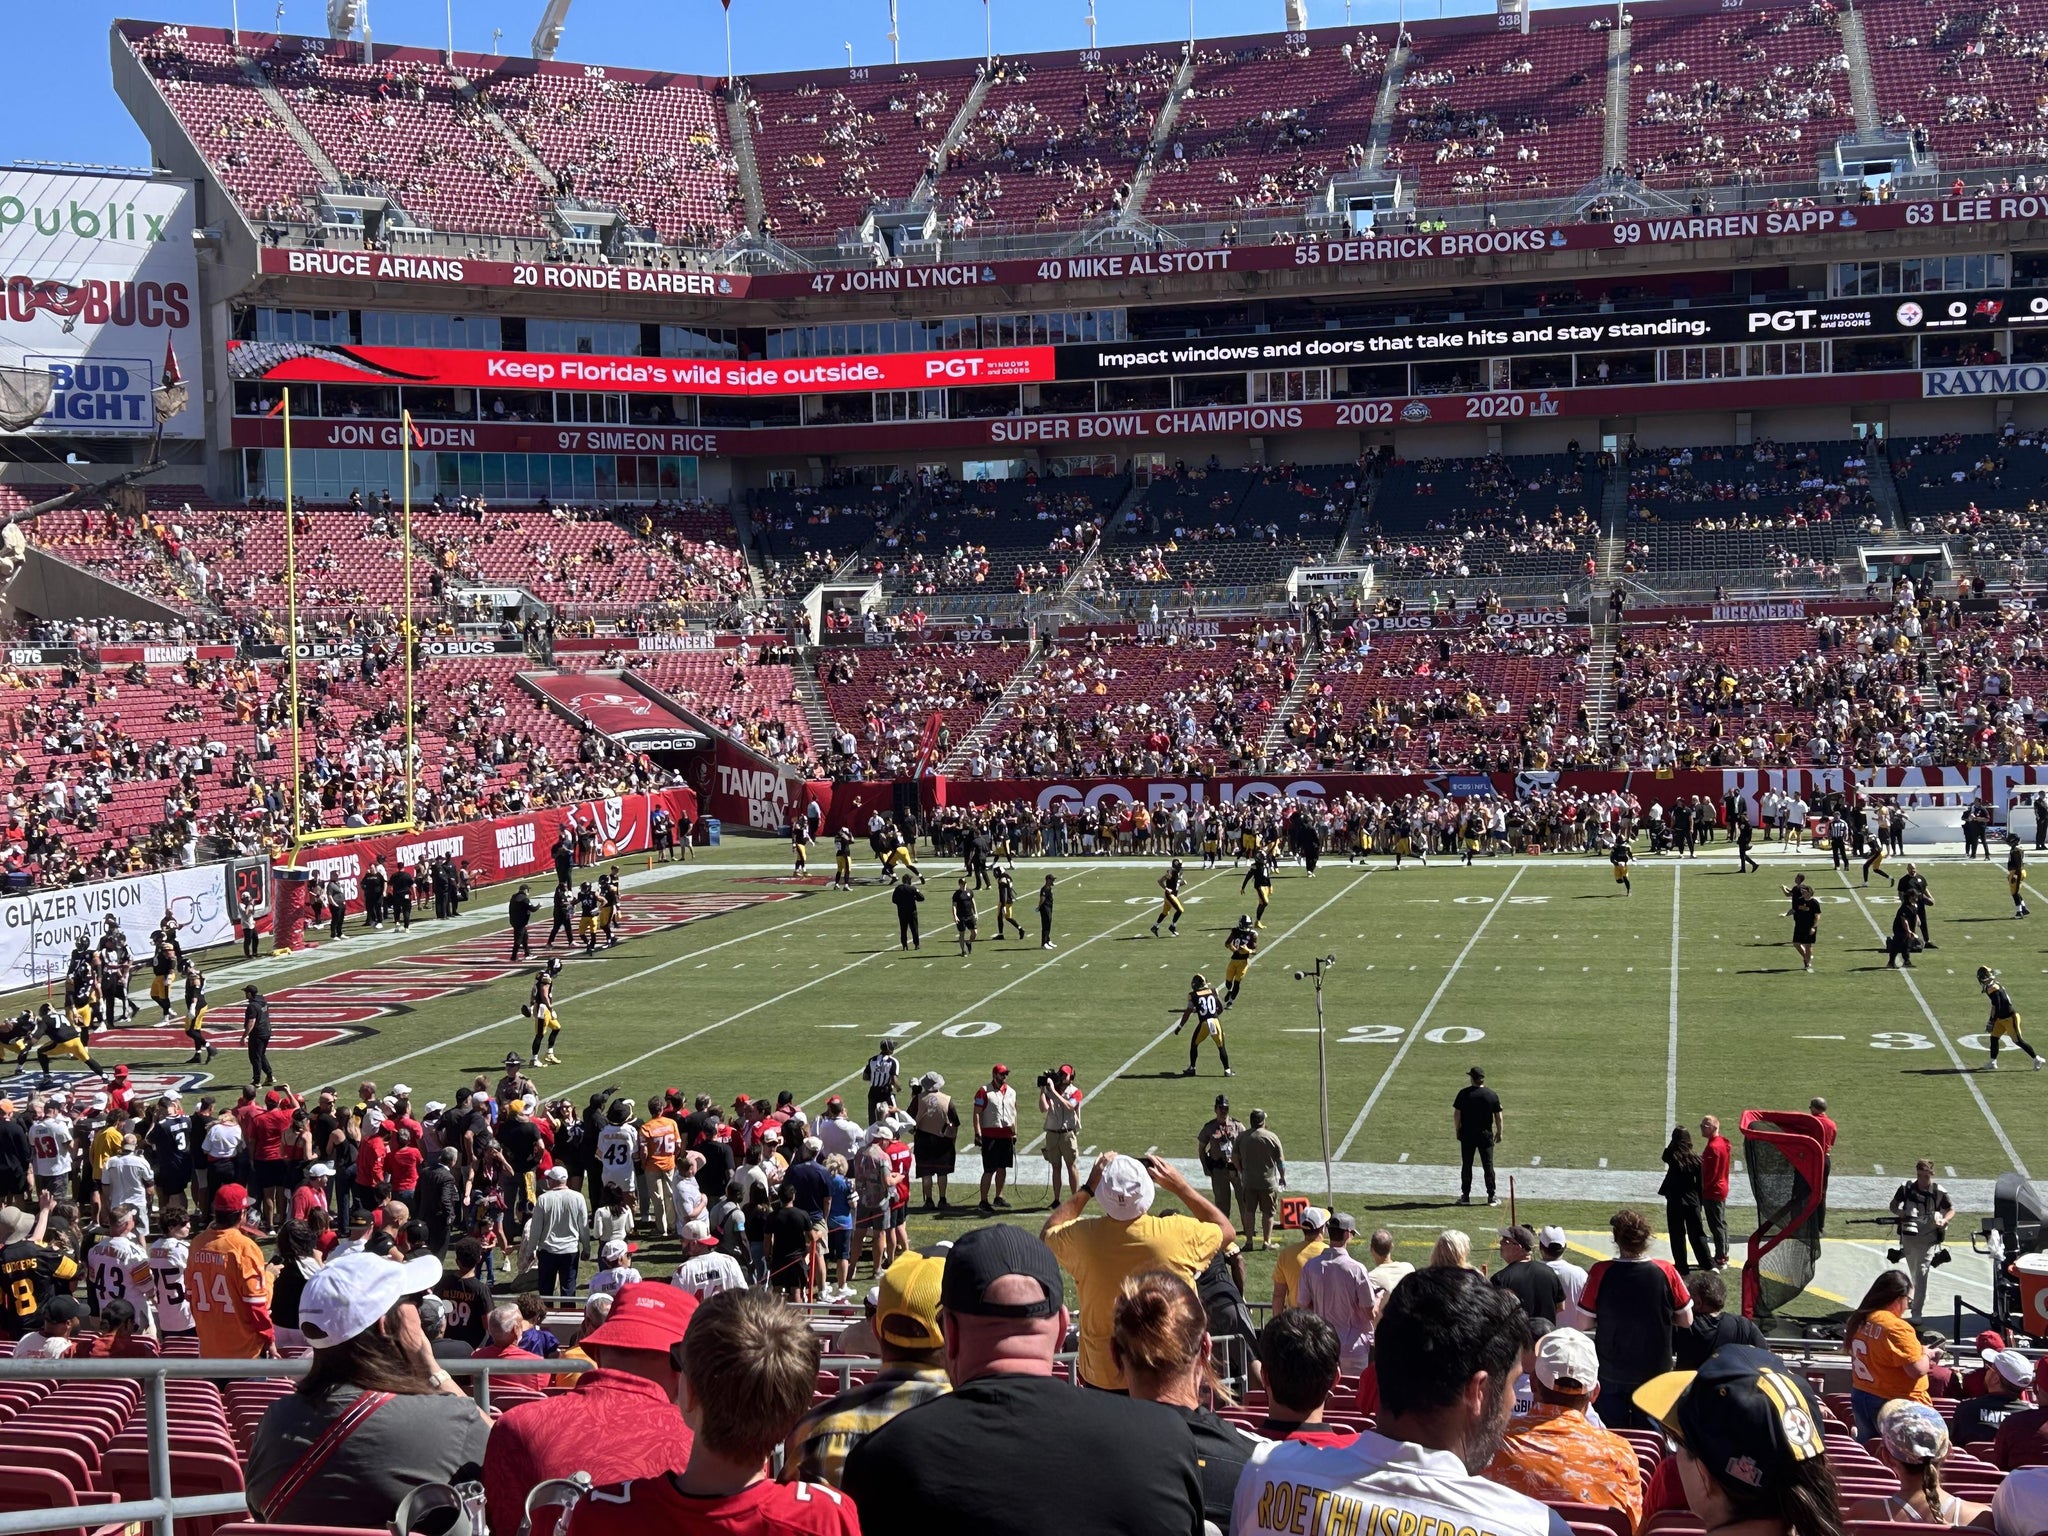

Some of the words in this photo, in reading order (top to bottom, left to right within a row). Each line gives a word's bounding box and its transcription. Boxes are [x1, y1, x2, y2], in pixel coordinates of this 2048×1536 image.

[1498, 14, 1521, 26] 338
[163, 25, 188, 39] 344
[302, 39, 325, 51] 343
[1079, 50, 1101, 62] 340
[584, 66, 605, 79] 342
[849, 68, 869, 80] 341
[1906, 204, 1934, 225] 63
[1942, 200, 1992, 223] LEE
[1613, 224, 1641, 245] 99
[1647, 213, 1758, 242] WARREN
[1767, 210, 1834, 234] SAPP
[1295, 245, 1320, 265] 55
[1328, 236, 1433, 263] DERRICK
[1441, 229, 1545, 255] BROOKS
[289, 252, 371, 277] BRUCE
[377, 257, 464, 282] ARIANS
[1037, 261, 1062, 280] 40
[1068, 257, 1123, 279] MIKE
[1129, 250, 1232, 276] ALSTOTT
[513, 266, 538, 286] 20
[543, 267, 621, 290] RONDÉ
[627, 272, 716, 295] BARBER
[811, 272, 837, 293] 47
[840, 269, 899, 291] JOHN
[906, 265, 978, 288] LYNCH
[82, 279, 190, 328] BUCS
[1948, 301, 1967, 318] 0
[1748, 309, 1818, 332] PGT
[1820, 311, 1871, 321] WINDOWS
[1838, 319, 1872, 328] DOORS
[1098, 346, 1168, 368] Impact
[1172, 342, 1258, 363] windows
[1263, 341, 1301, 358] and
[1305, 338, 1365, 355] doors
[1368, 335, 1413, 351] that
[1416, 331, 1463, 349] take
[1467, 328, 1508, 345] hits
[1511, 325, 1553, 342] and
[1556, 324, 1604, 342] stay
[1608, 318, 1711, 338] standing.
[487, 358, 555, 382] Keep
[672, 364, 720, 385] wild
[726, 366, 779, 387] side
[783, 362, 885, 386] outside.
[926, 357, 984, 378] PGT
[987, 360, 1030, 368] WINDOWS
[48, 364, 129, 392] BUD
[1336, 403, 1393, 426] 2002
[1466, 396, 1524, 419] 2020
[991, 413, 1069, 442] SUPER
[1077, 411, 1149, 438] BOWL
[1155, 407, 1302, 435] CHAMPIONS
[328, 425, 373, 446] JON
[381, 427, 476, 447] GRUDEN
[558, 431, 581, 450] 97
[587, 432, 665, 452] SIMEON
[670, 435, 717, 453] RICE
[1306, 571, 1358, 581] METERS
[1383, 616, 1432, 629] BUCS
[1486, 614, 1516, 626] GO
[1518, 612, 1567, 625] BUCS
[1712, 604, 1804, 620] BUCCANEERS
[954, 629, 993, 641] 1976
[1137, 621, 1220, 636] BUCCANEERS
[313, 643, 364, 656] BUCS
[449, 641, 495, 655] BUCS
[638, 637, 715, 650] BUCCANEERS
[9, 649, 42, 664] 1976
[629, 740, 672, 751] GEICO
[717, 765, 789, 804] TAMPA
[748, 798, 789, 831] BAY
[495, 826, 518, 849] BUCS
[517, 823, 536, 845] FLAG
[427, 835, 464, 860] STUDENT
[499, 843, 536, 869] FOOTBALL
[237, 869, 262, 908] 25
[5, 896, 77, 928] GLAZER
[82, 883, 142, 916] VISION
[1198, 995, 1217, 1016] 30
[879, 1020, 1003, 1038] 10
[1336, 1025, 1486, 1044] 20
[1869, 1032, 2023, 1051] 30
[35, 1136, 58, 1159] 13
[175, 1131, 187, 1151] 3
[653, 1133, 675, 1155] 76
[604, 1143, 628, 1166] 43
[91, 1263, 126, 1301] 43
[193, 1271, 236, 1313] 14
[11, 1278, 38, 1317] 8
[448, 1300, 471, 1327] 89
[1852, 1339, 1874, 1382] 6
